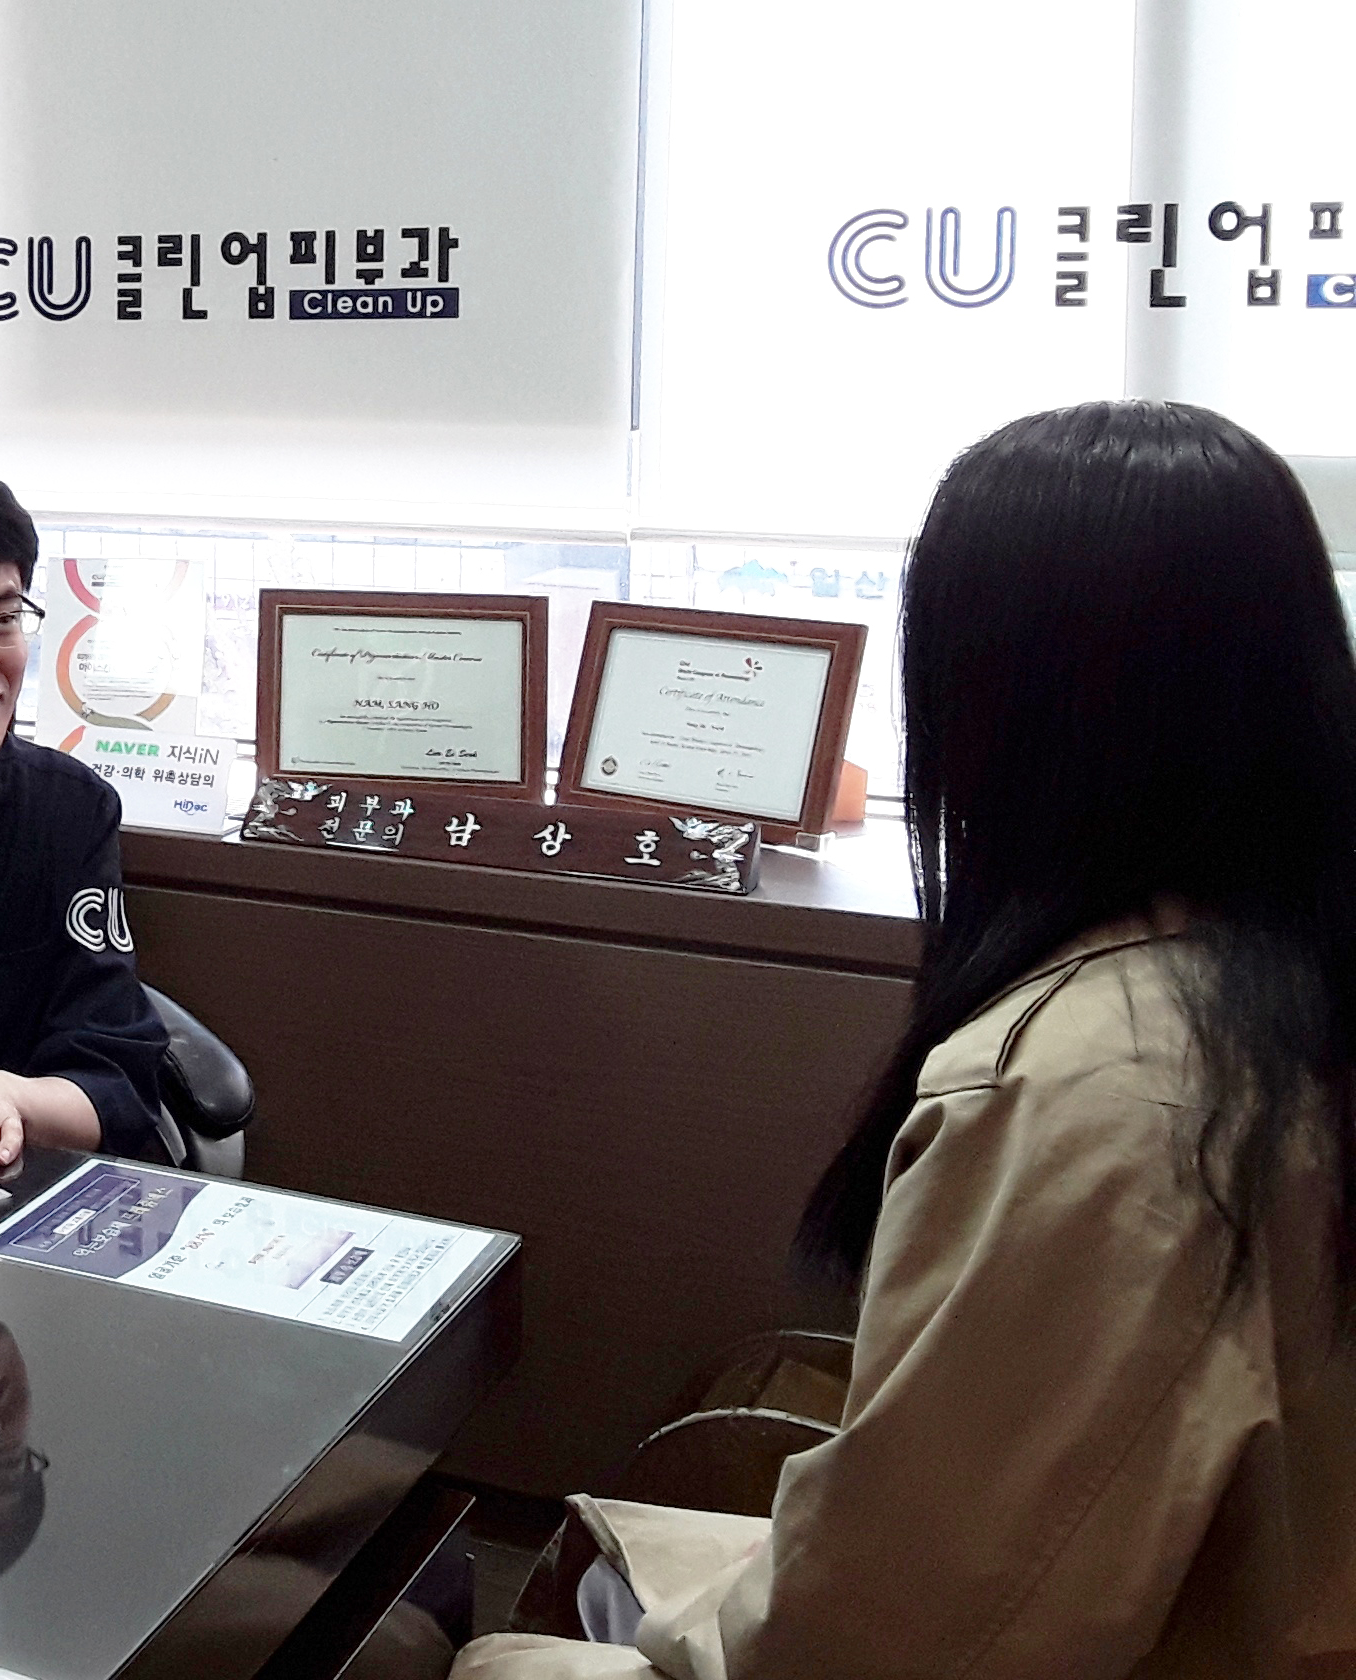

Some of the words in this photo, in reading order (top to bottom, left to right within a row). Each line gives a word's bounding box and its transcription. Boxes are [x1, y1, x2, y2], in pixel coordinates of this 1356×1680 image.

[827, 205, 1017, 309] CU
[116, 226, 460, 320] 클린업피부과
[301, 291, 395, 314] Clean
[406, 291, 445, 318] Up
[95, 739, 160, 757] NAVER
[166, 744, 220, 766] 지식iN
[327, 791, 415, 821] 피부과
[317, 816, 404, 846] 전문의
[65, 886, 134, 953] CU
